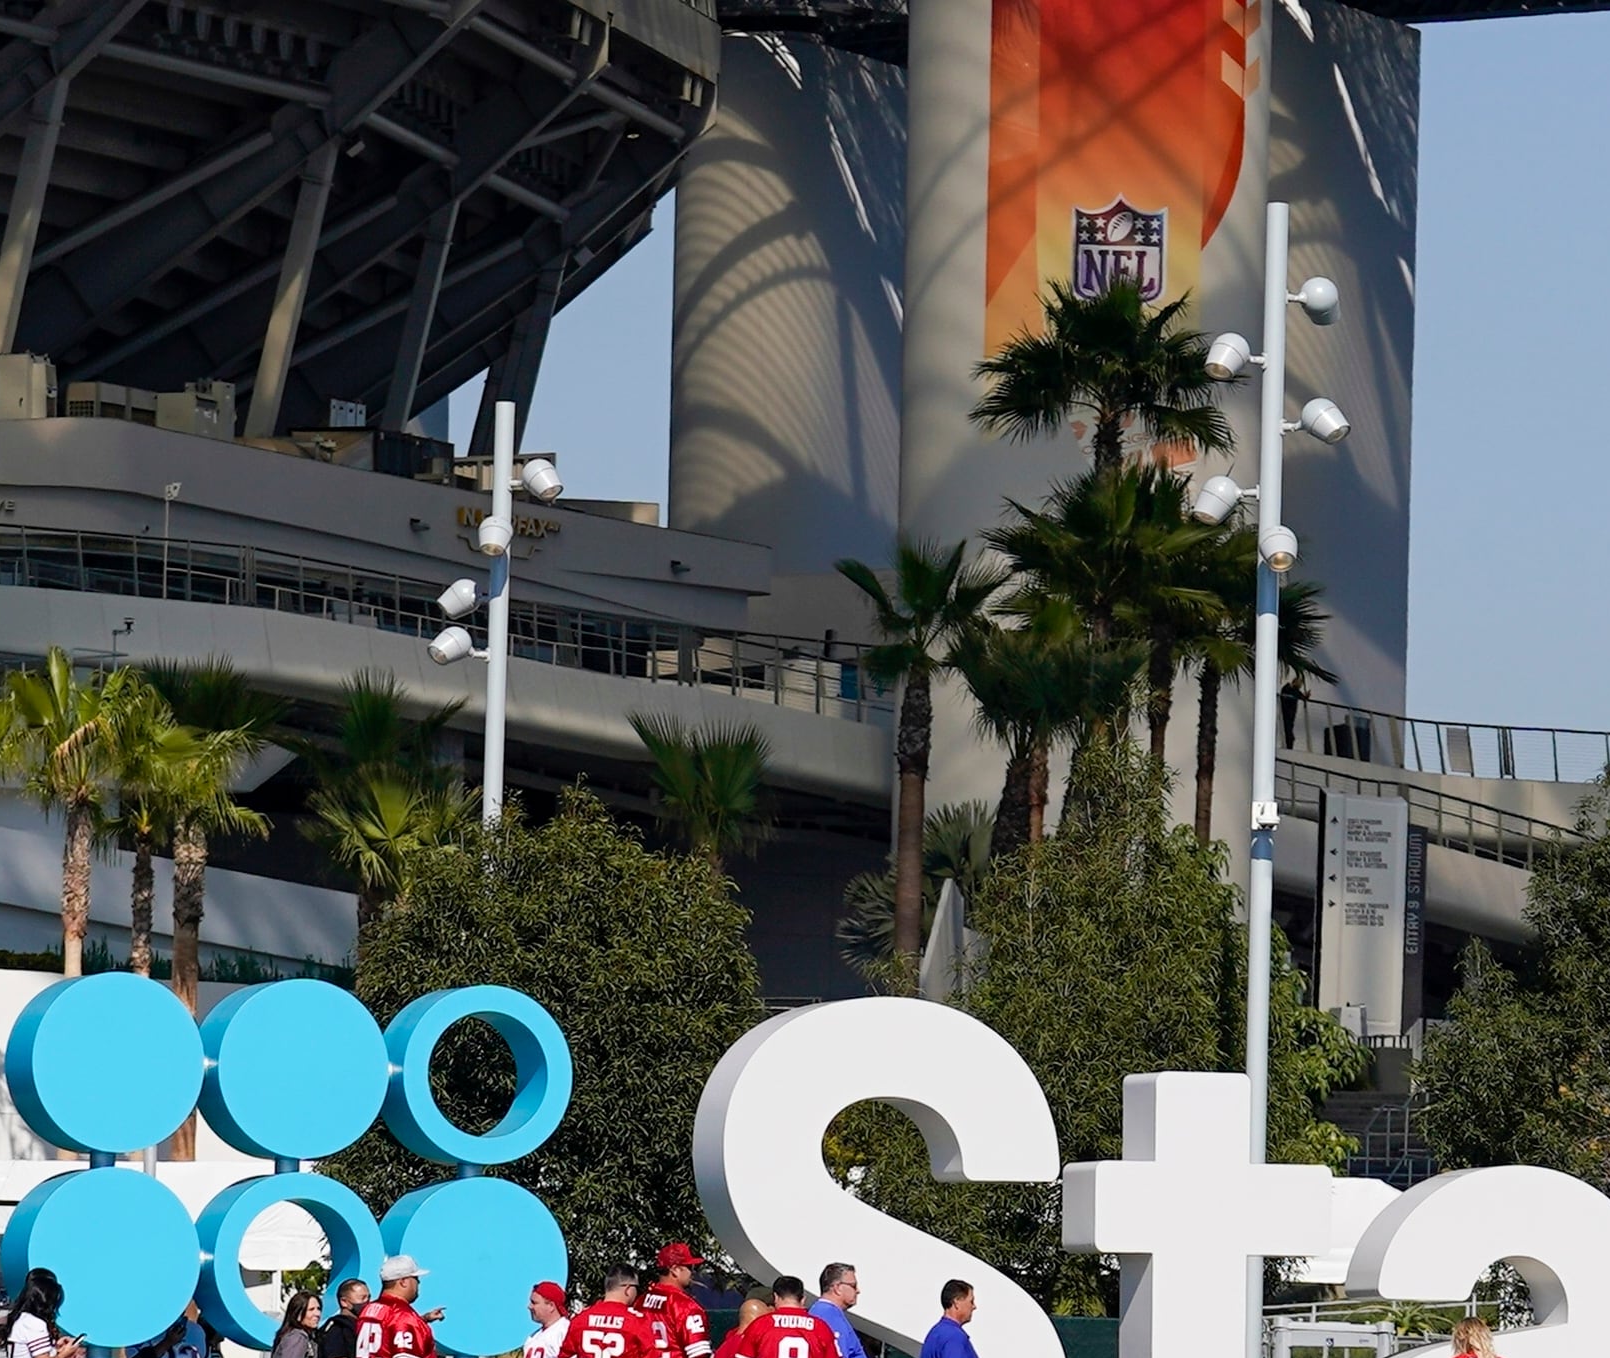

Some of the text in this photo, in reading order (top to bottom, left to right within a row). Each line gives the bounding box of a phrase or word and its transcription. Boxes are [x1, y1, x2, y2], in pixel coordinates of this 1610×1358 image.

[1078, 249, 1156, 295] NFL
[1408, 833, 1423, 893] STADIUM
[588, 1314, 624, 1329] WILLIS
[772, 1314, 815, 1330] YOUNG
[393, 1331, 413, 1350] 42
